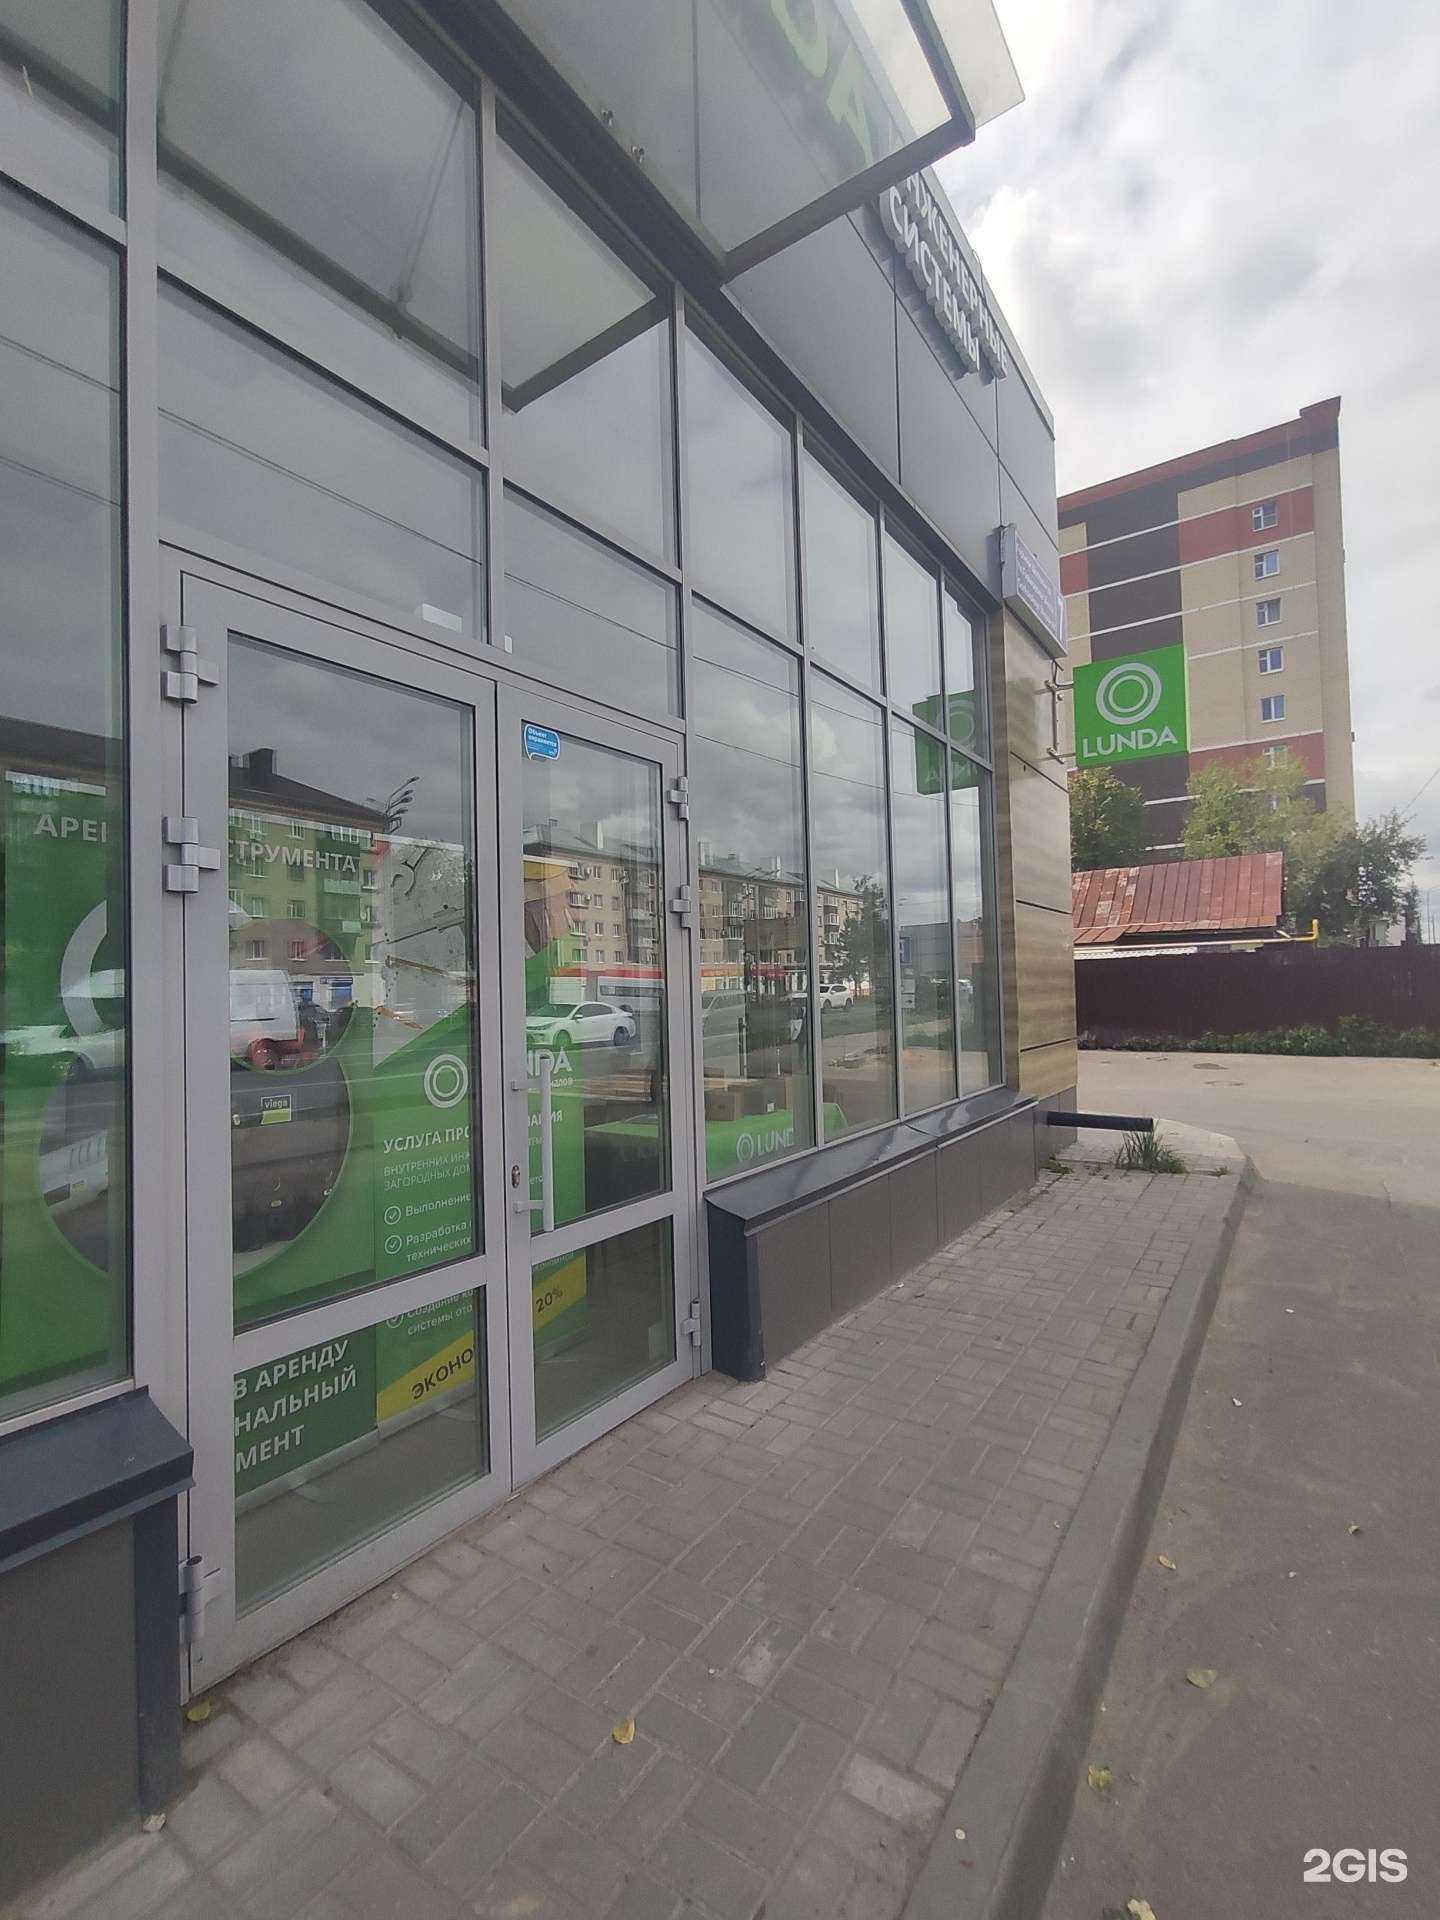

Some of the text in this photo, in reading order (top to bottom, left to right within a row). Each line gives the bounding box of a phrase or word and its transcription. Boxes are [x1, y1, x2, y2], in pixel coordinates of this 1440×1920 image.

[885, 186, 981, 372] СИСТЕМЫ
[1082, 725, 1178, 758] LUNDA
[383, 1130, 442, 1154] УСЛУГА
[406, 1221, 466, 1246] Разработка
[407, 1311, 453, 1336] системы
[254, 1339, 349, 1393] АРЕНДУ
[411, 1348, 474, 1400] ЭКОНО
[234, 1364, 357, 1437] НАЛЬНЫЙ
[235, 1424, 305, 1473] МЕНТ
